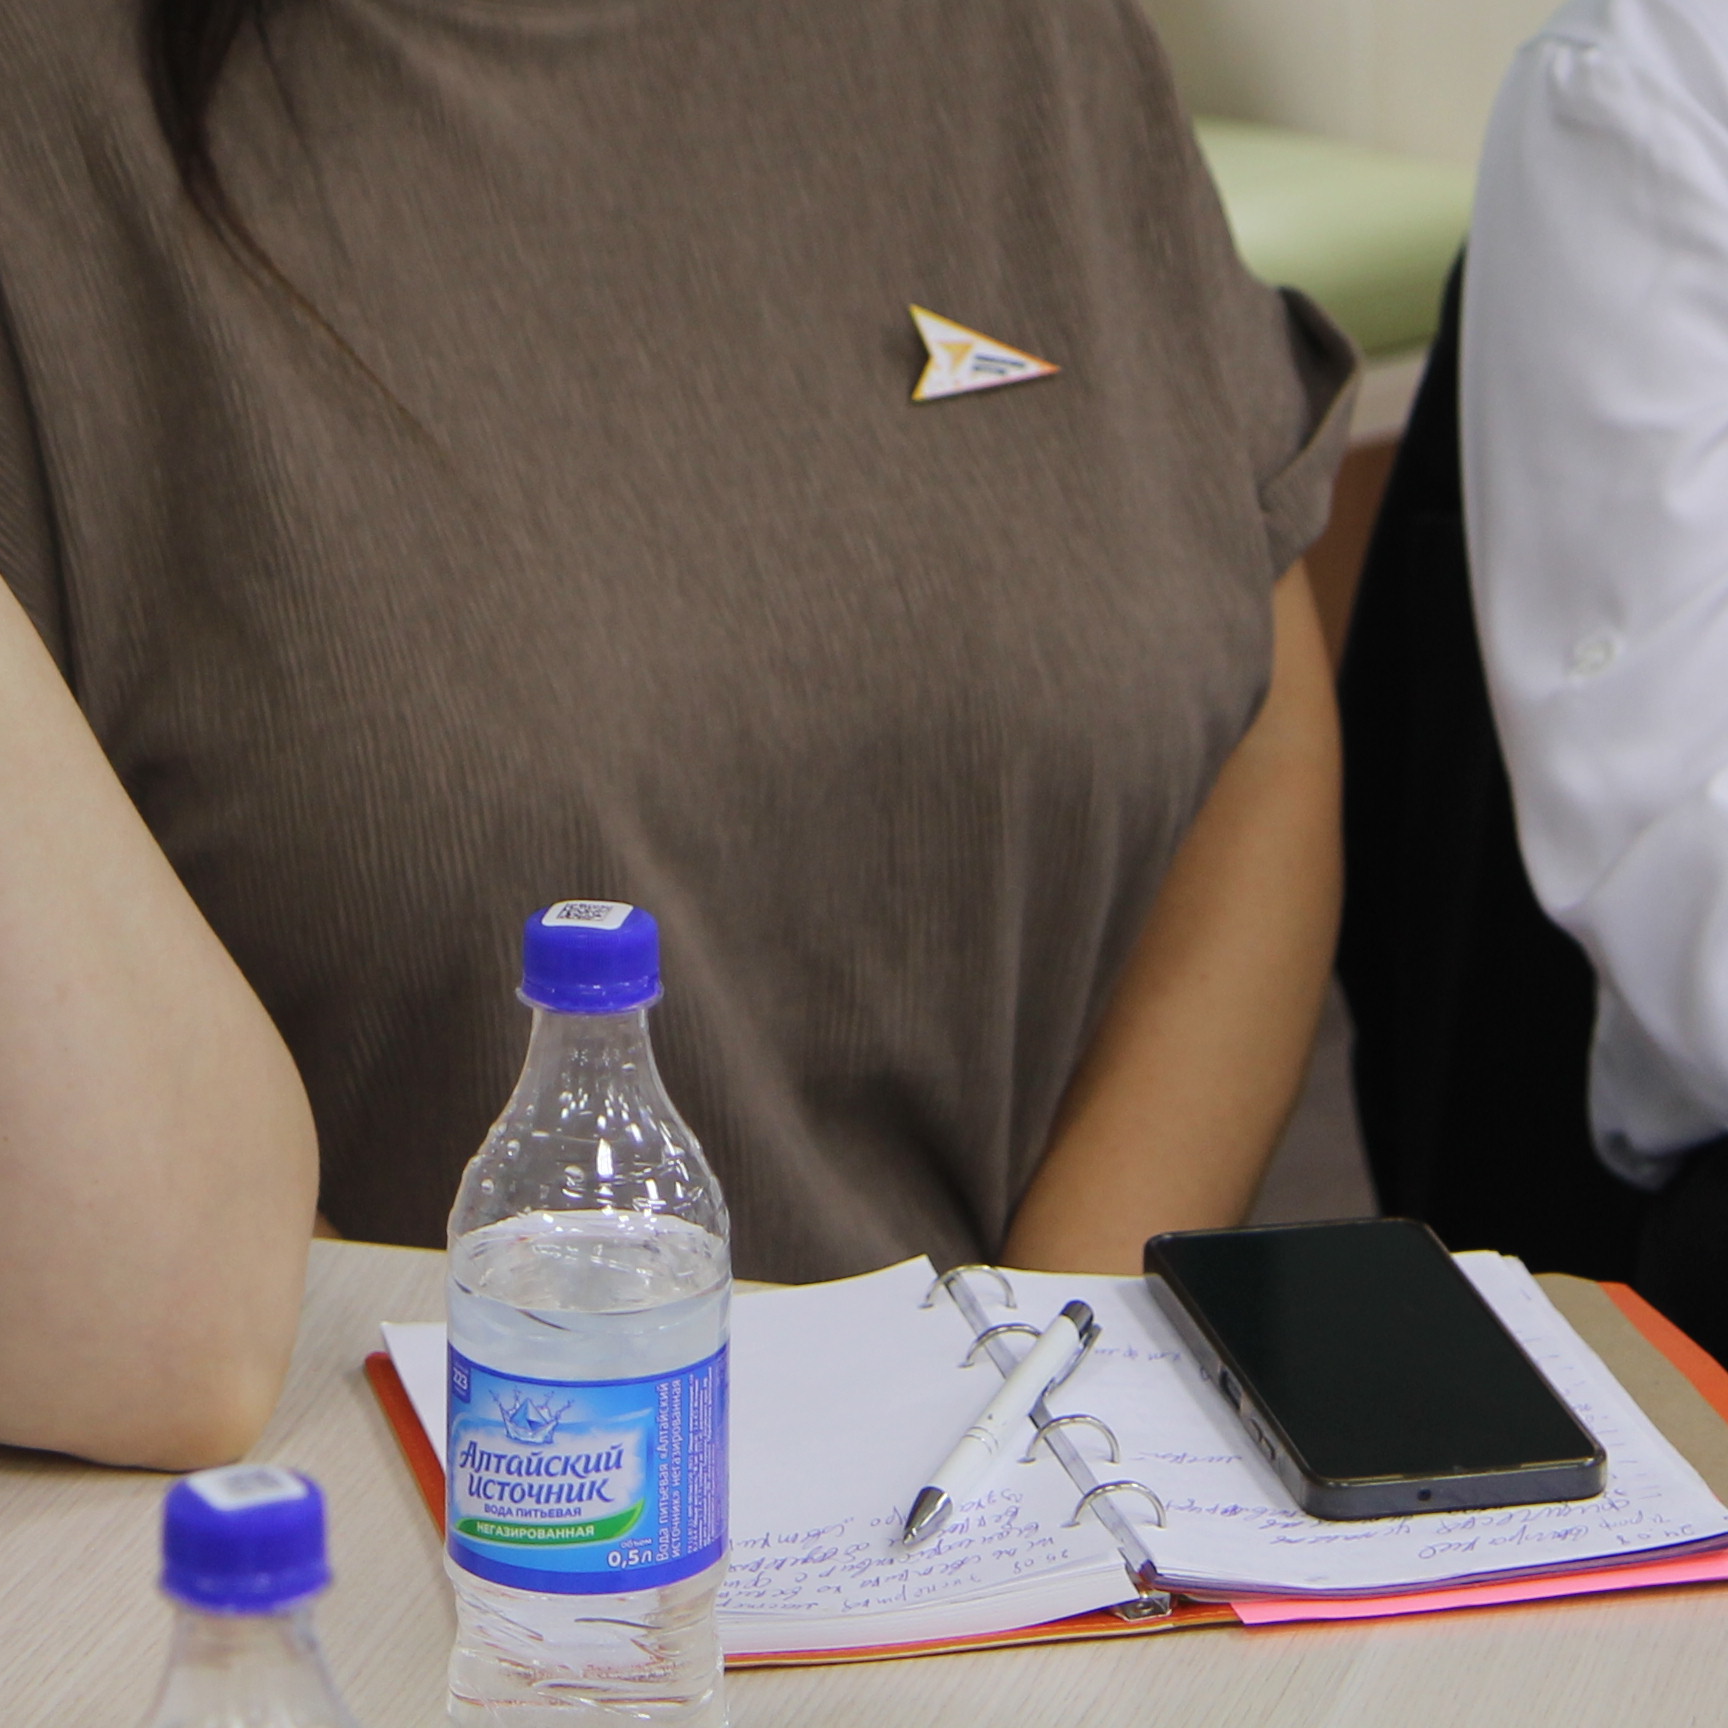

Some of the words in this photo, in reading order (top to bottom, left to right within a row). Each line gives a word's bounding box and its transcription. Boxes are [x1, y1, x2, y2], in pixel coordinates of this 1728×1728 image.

[656, 1381, 670, 1460] «Алтайский
[672, 1378, 683, 1488] негазированная
[459, 1439, 625, 1479] Алтайский
[484, 1503, 514, 1517] ВОДА
[516, 1506, 582, 1519] ПИТЬЕВАЯ
[658, 1462, 670, 1524] питьевая
[476, 1521, 595, 1540] НЕГАЗИРОВАННАЯ
[656, 1526, 670, 1562] Вода
[672, 1490, 681, 1558] источник»
